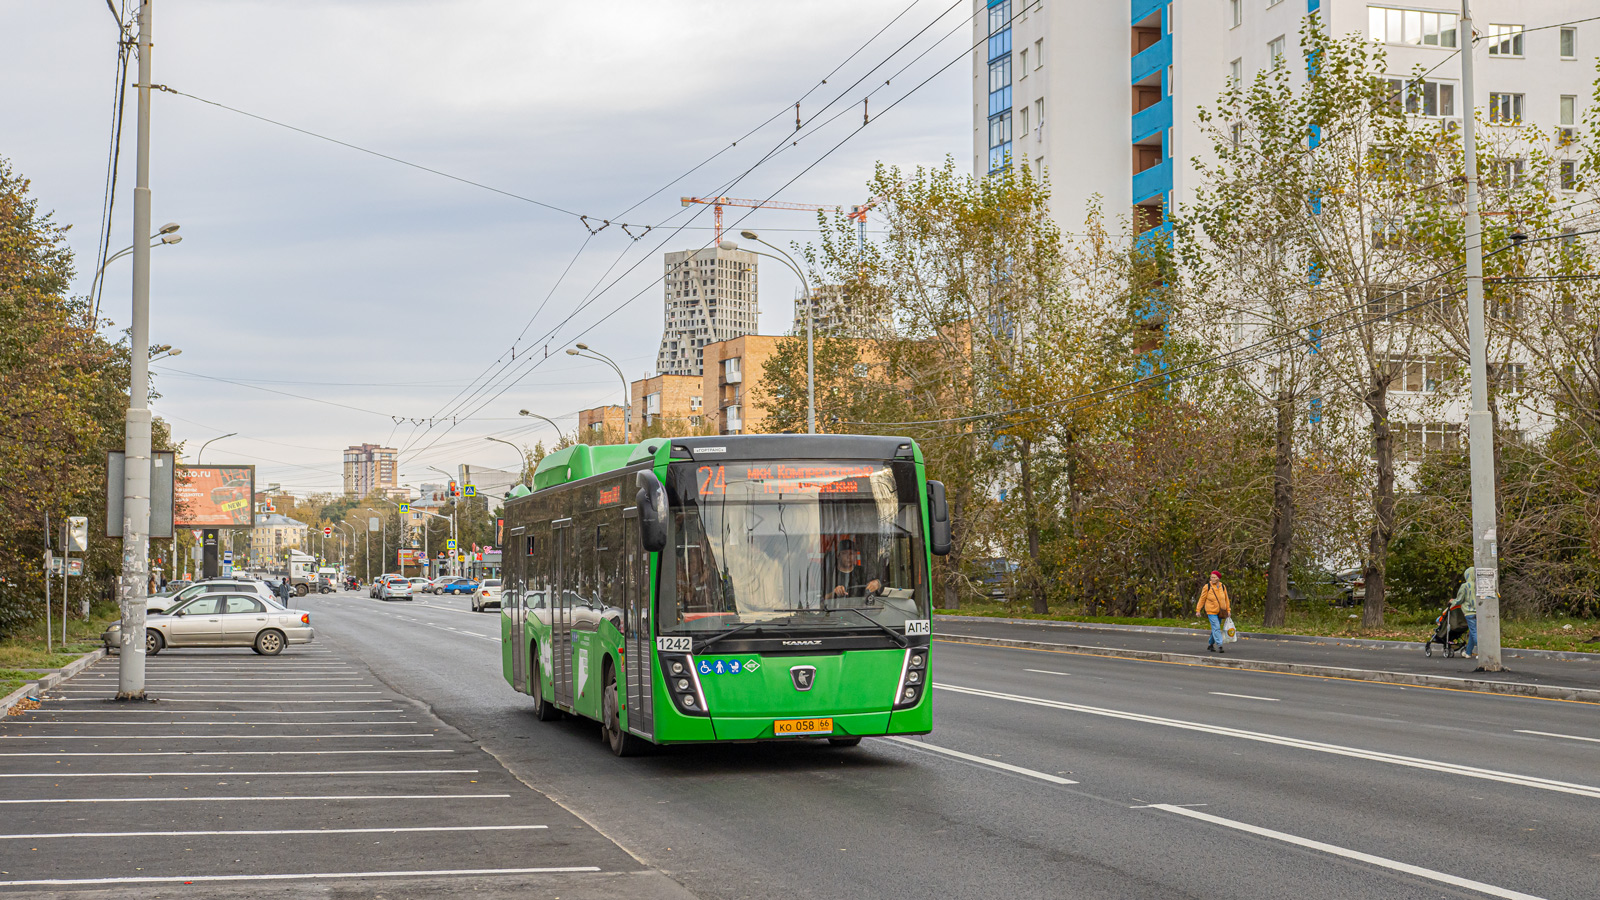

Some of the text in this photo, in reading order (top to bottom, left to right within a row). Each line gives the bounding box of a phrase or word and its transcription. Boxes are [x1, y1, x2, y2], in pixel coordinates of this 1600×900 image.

[747, 464, 873, 480] мкн. Компрессорный
[698, 465, 727, 495] 24
[778, 480, 858, 494] Мичуринский
[228, 501, 242, 510] NEW
[907, 622, 929, 633] АП-6
[659, 638, 690, 650] 1242
[796, 720, 815, 731] 058
[820, 719, 830, 727] 66
